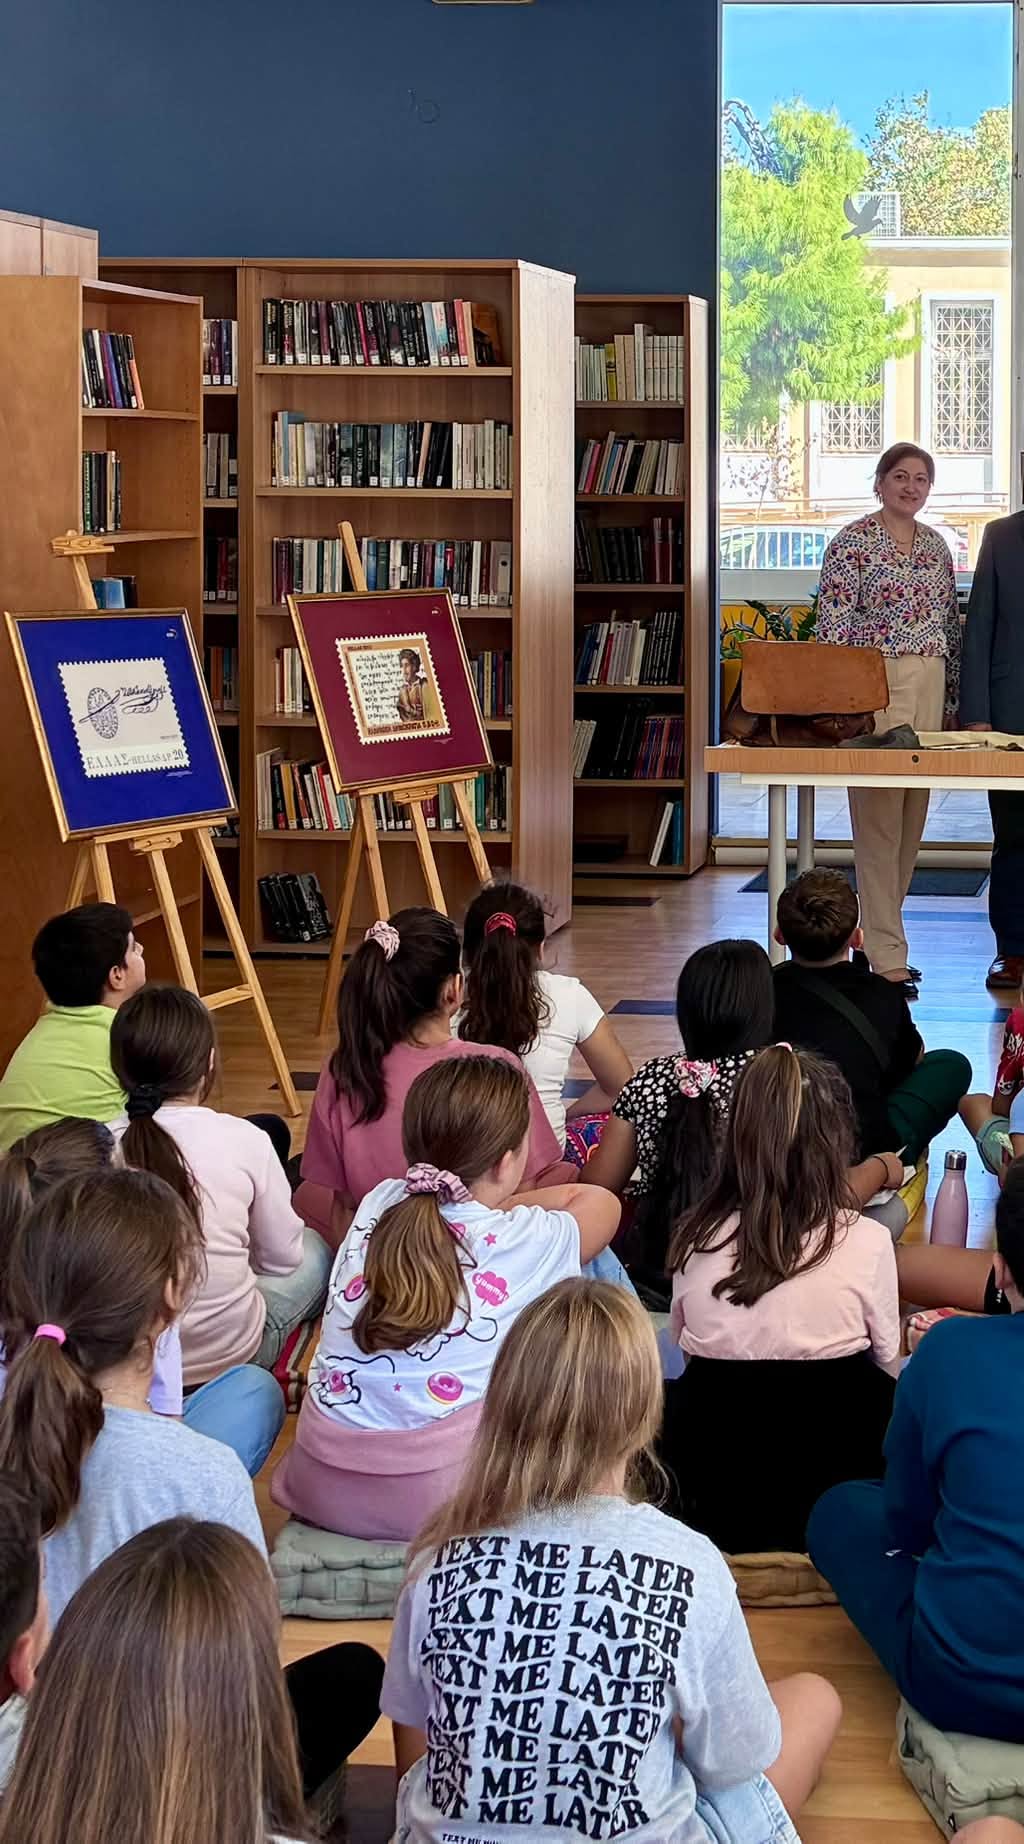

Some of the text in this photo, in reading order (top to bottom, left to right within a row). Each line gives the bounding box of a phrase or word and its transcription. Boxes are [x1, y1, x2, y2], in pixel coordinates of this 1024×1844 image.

[173, 749, 184, 761] 20
[427, 1558, 689, 1628] TEXT ME LATER
[434, 1536, 694, 1598] TEXT ME LATER
[428, 1587, 682, 1658] TEXT ME LATER
[492, 1660, 551, 1694] ME
[558, 1660, 666, 1708] LATER
[499, 1631, 557, 1663] ME
[565, 1632, 677, 1687] LATER
[433, 1682, 482, 1731] XT
[489, 1696, 545, 1734] ME
[482, 1725, 539, 1762] ME
[548, 1741, 647, 1781] LATE
[480, 1766, 537, 1800] ME
[547, 1766, 640, 1806] LAT
[478, 1796, 534, 1825] ME
[542, 1793, 650, 1841] LATER
